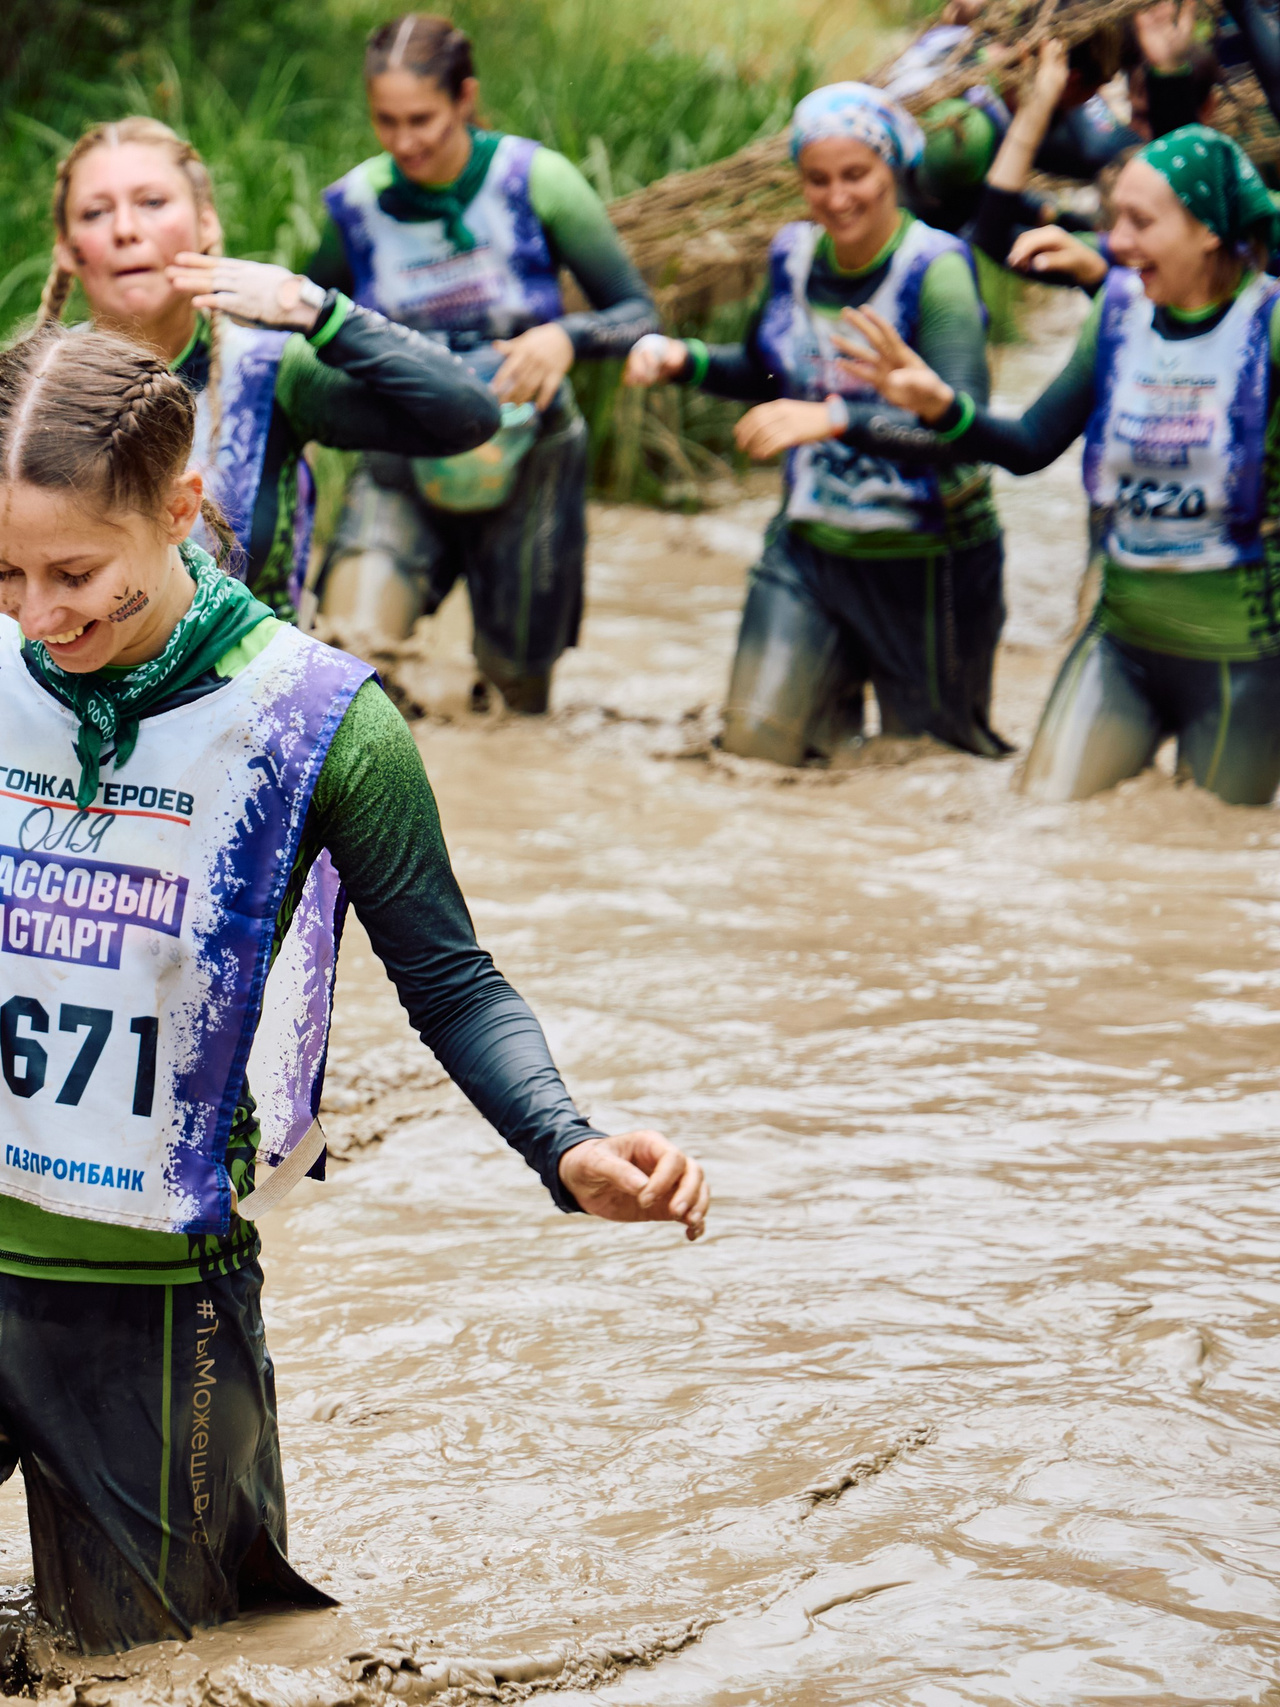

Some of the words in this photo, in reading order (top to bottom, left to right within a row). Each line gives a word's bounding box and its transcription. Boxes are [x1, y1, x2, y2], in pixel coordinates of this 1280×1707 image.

[108, 589, 144, 619] ГОНКА
[97, 781, 195, 816] ЕРОЕВ
[8, 907, 119, 963] СТАРТ
[5, 1143, 145, 1193] ГАЗПРОМБАНК
